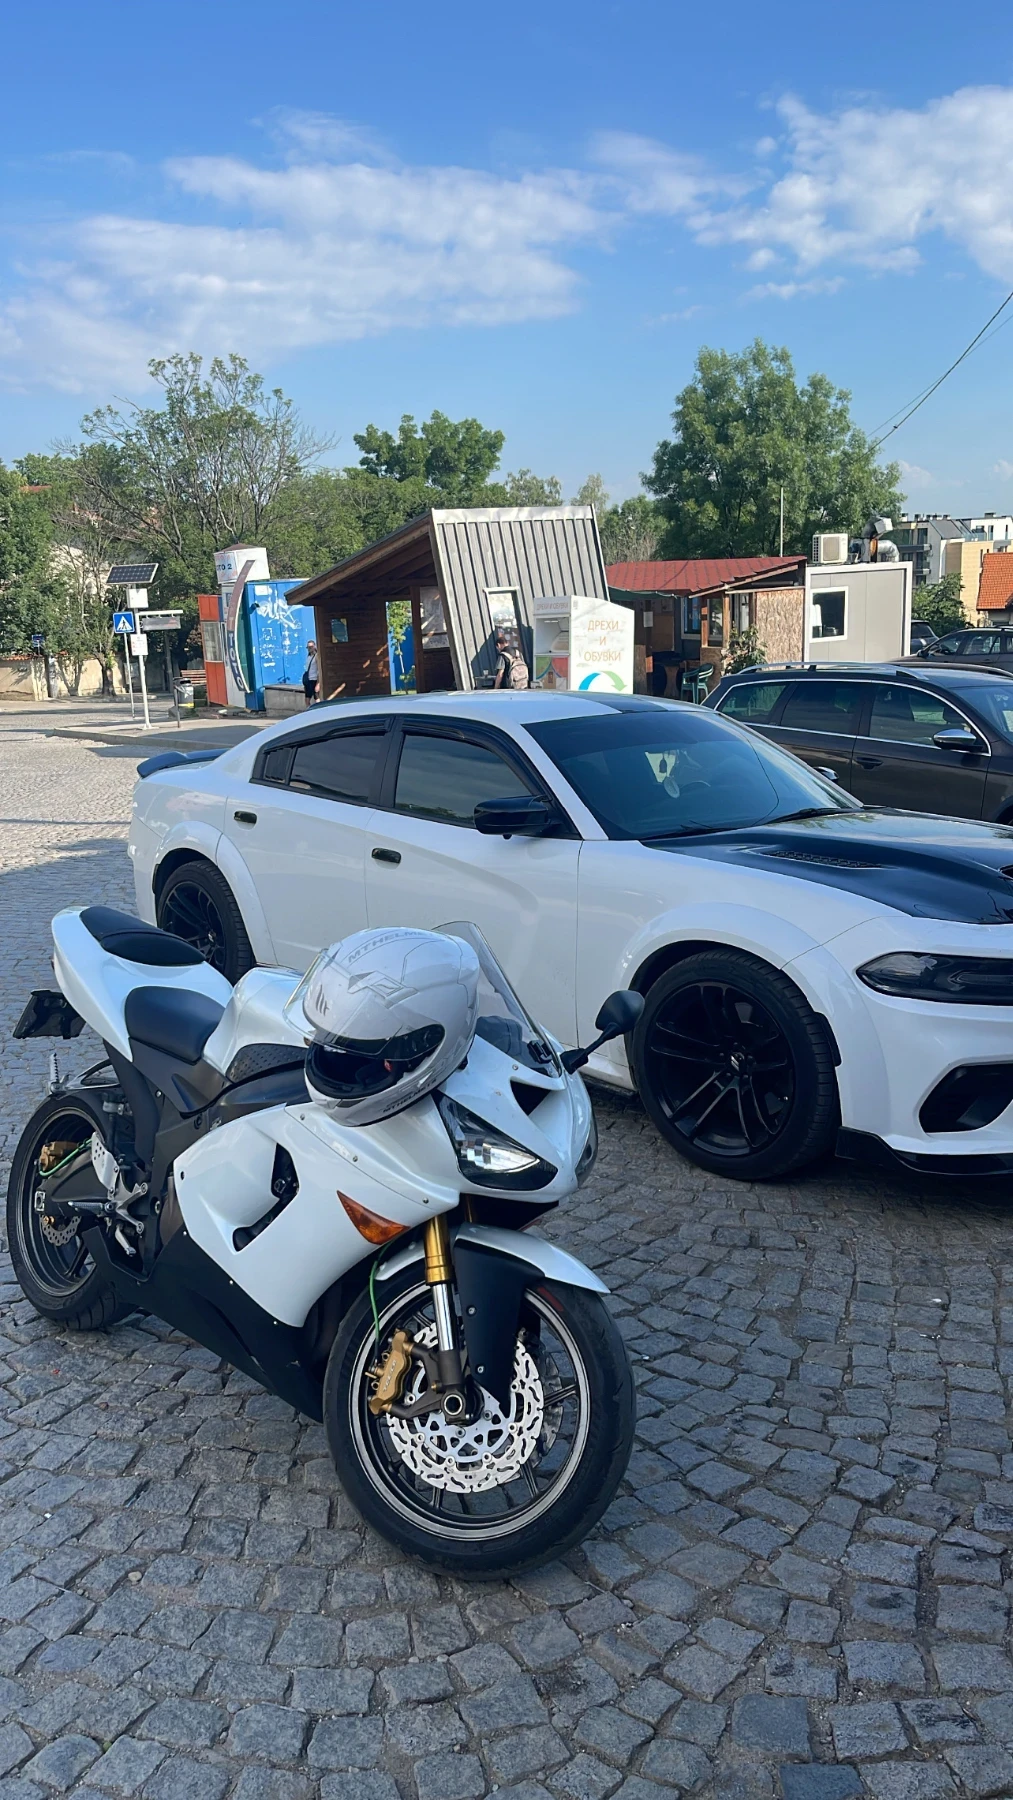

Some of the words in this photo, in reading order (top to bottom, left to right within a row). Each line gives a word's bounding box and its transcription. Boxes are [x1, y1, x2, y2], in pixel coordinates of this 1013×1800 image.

[587, 620, 619, 632] ДРЕХИ
[599, 636, 607, 646] И
[228, 632, 244, 690] ТОТО
[584, 651, 622, 662] ОБУВКИ
